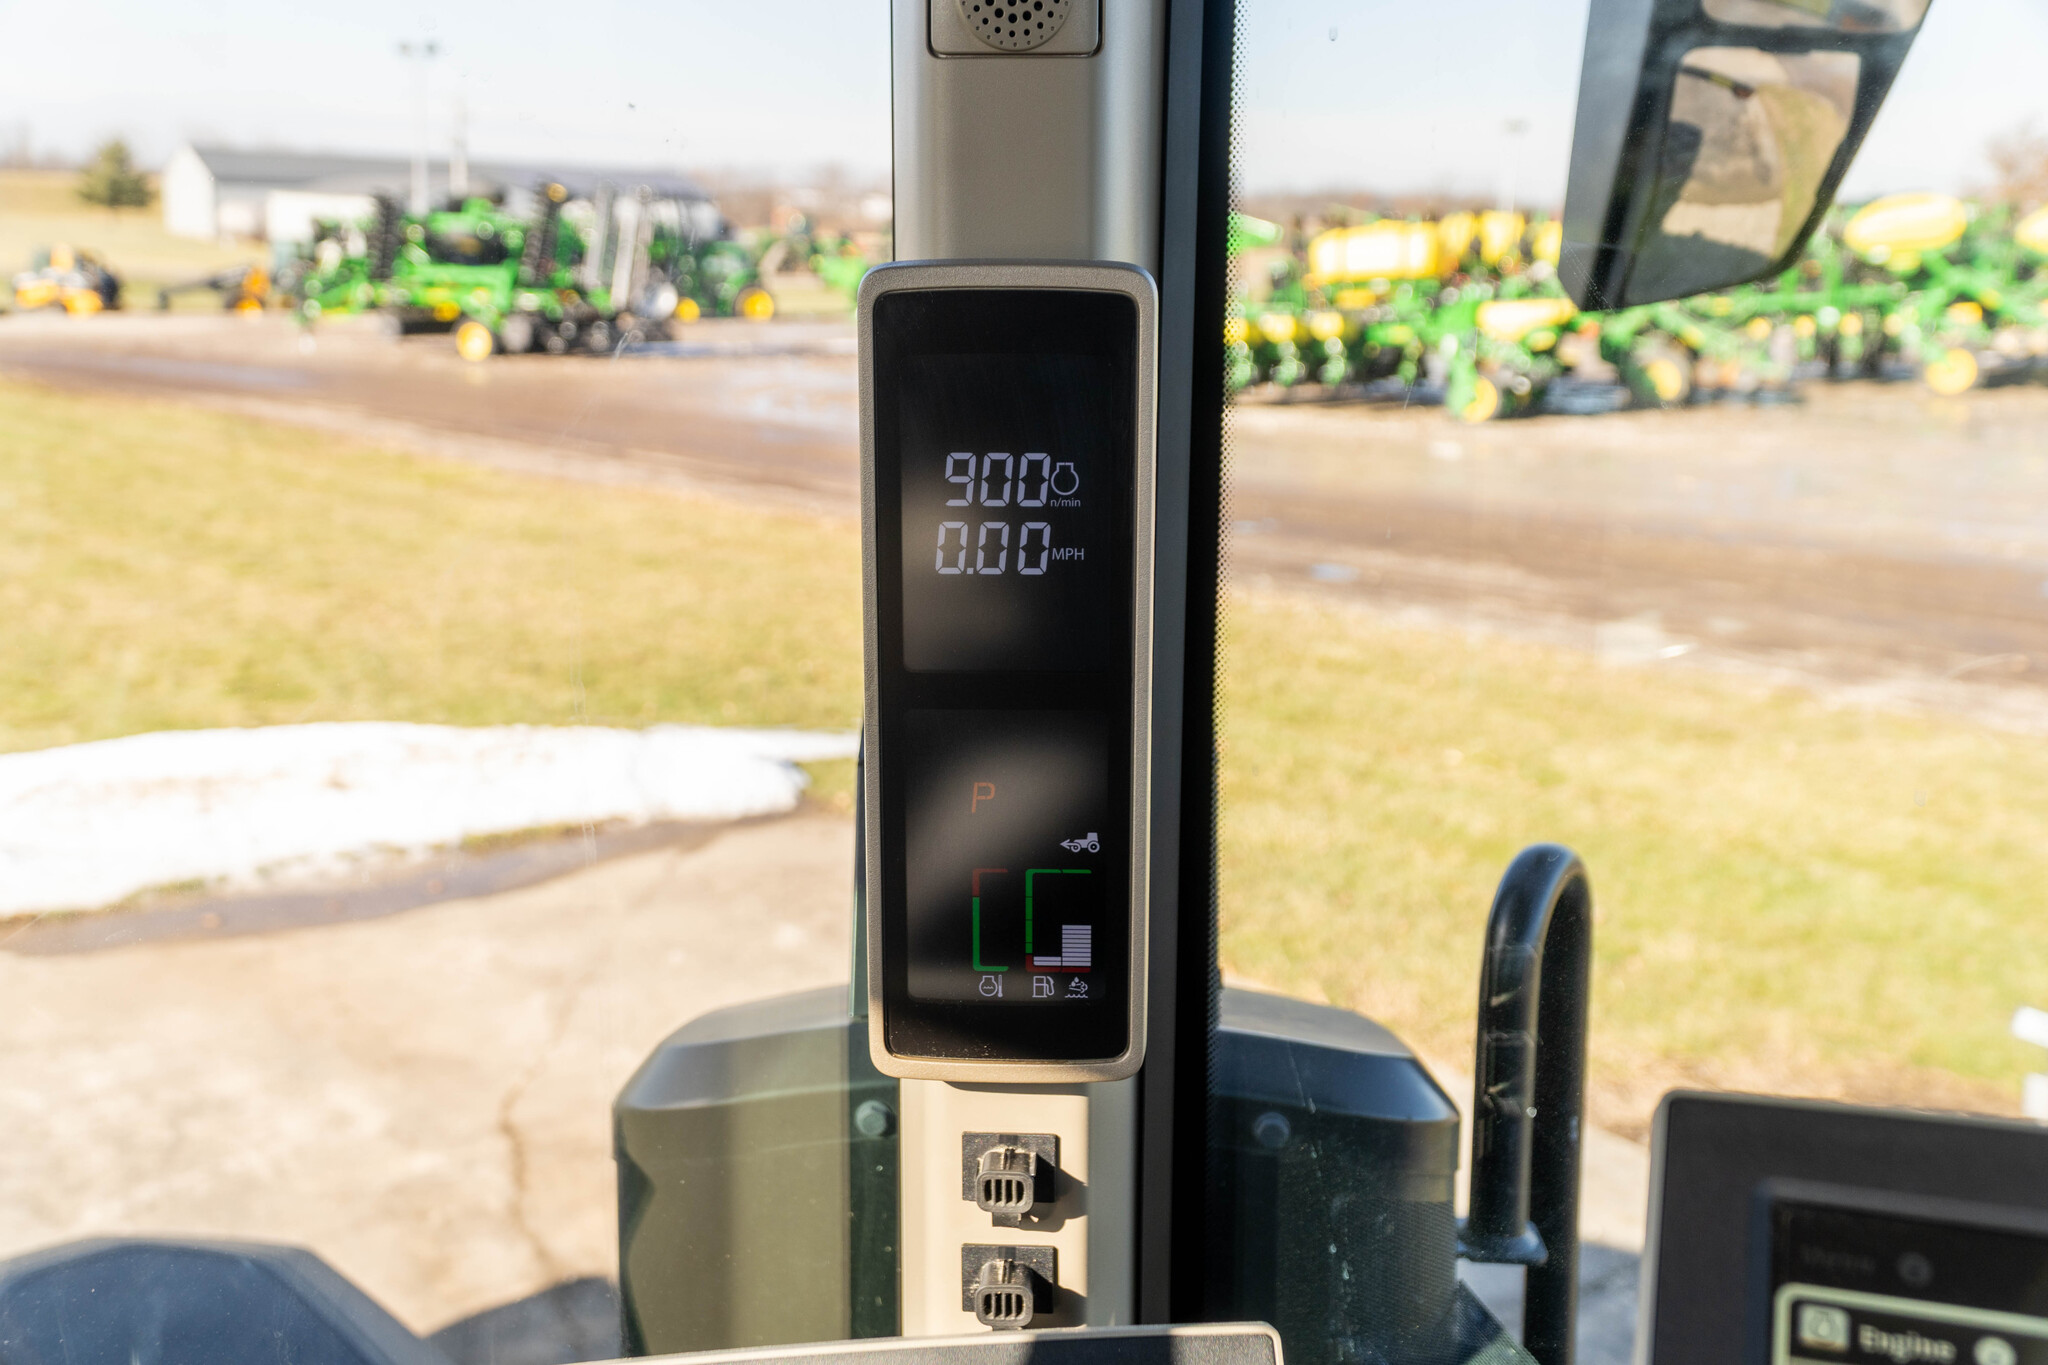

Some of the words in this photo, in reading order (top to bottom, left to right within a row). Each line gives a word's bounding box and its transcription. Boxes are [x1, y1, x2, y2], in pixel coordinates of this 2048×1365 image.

[945, 452, 1051, 507] 900
[1050, 497, 1081, 507] n/min
[935, 521, 1051, 575] 0.00
[1052, 547, 1085, 560] MPH
[972, 781, 996, 813] P
[1858, 1324, 1957, 1361] Engine
